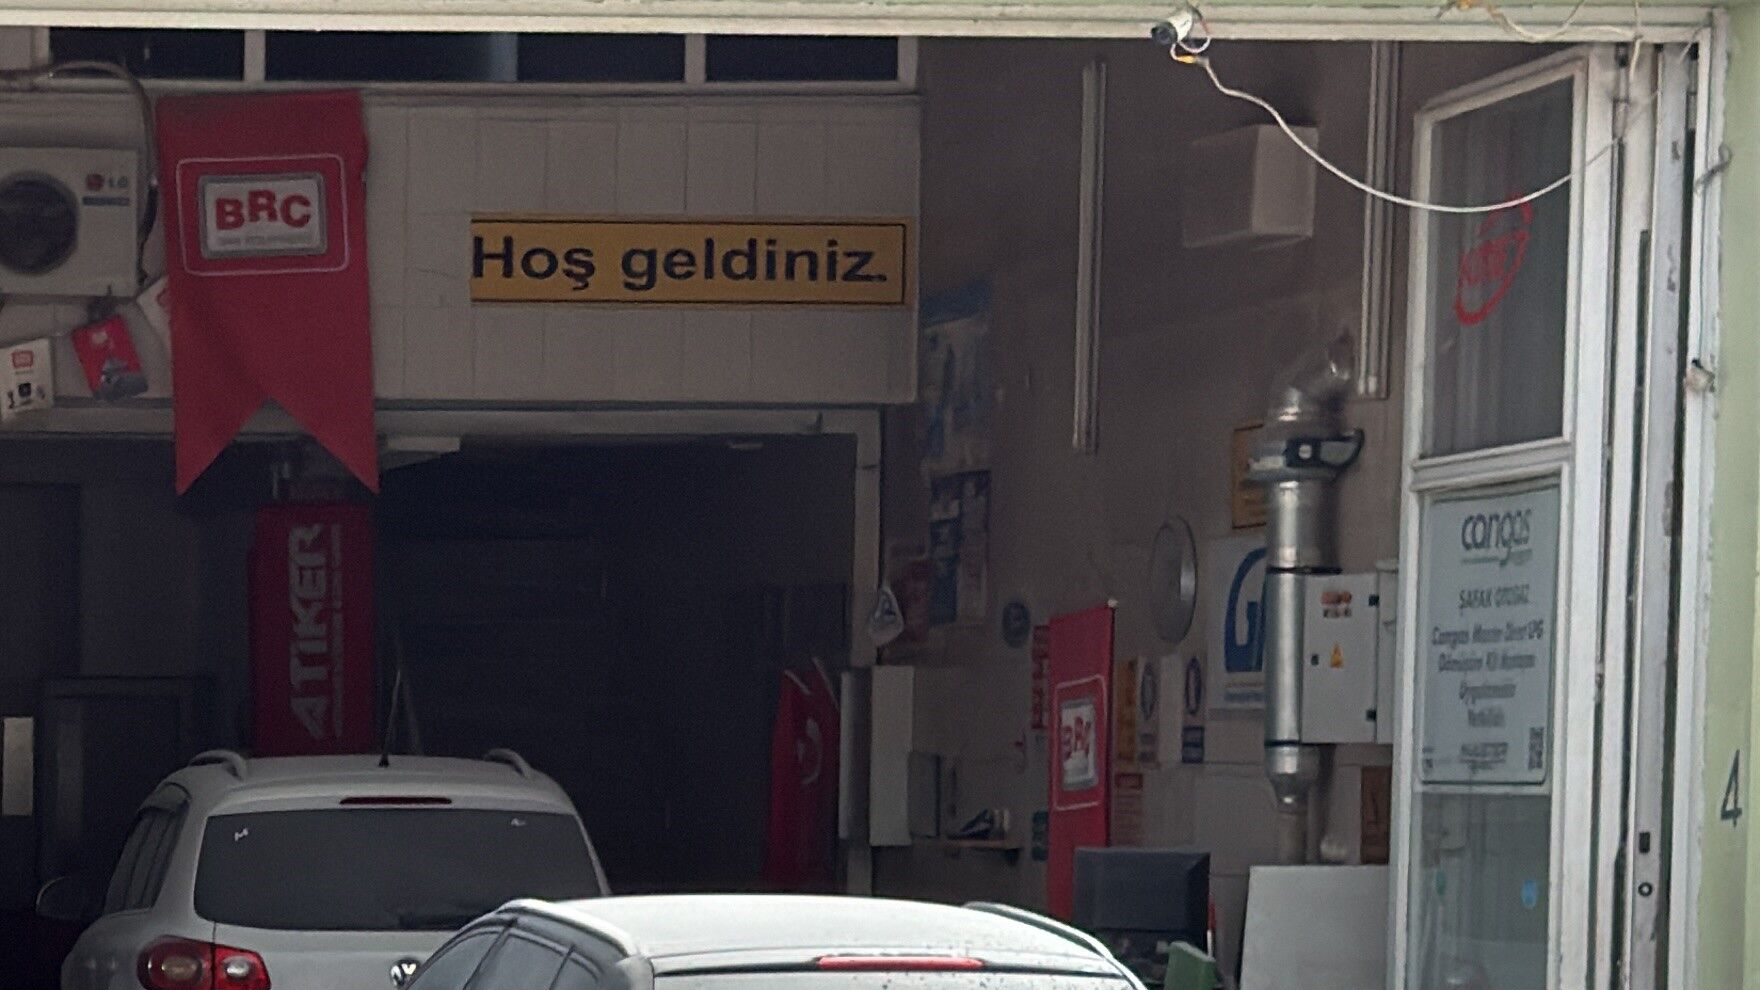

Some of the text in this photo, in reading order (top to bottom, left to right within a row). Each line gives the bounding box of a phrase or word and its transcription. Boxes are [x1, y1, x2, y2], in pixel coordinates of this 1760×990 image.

[215, 189, 312, 231] BRC
[472, 235, 888, 292] Hoş geldiniz.
[1721, 748, 1743, 829] 4
